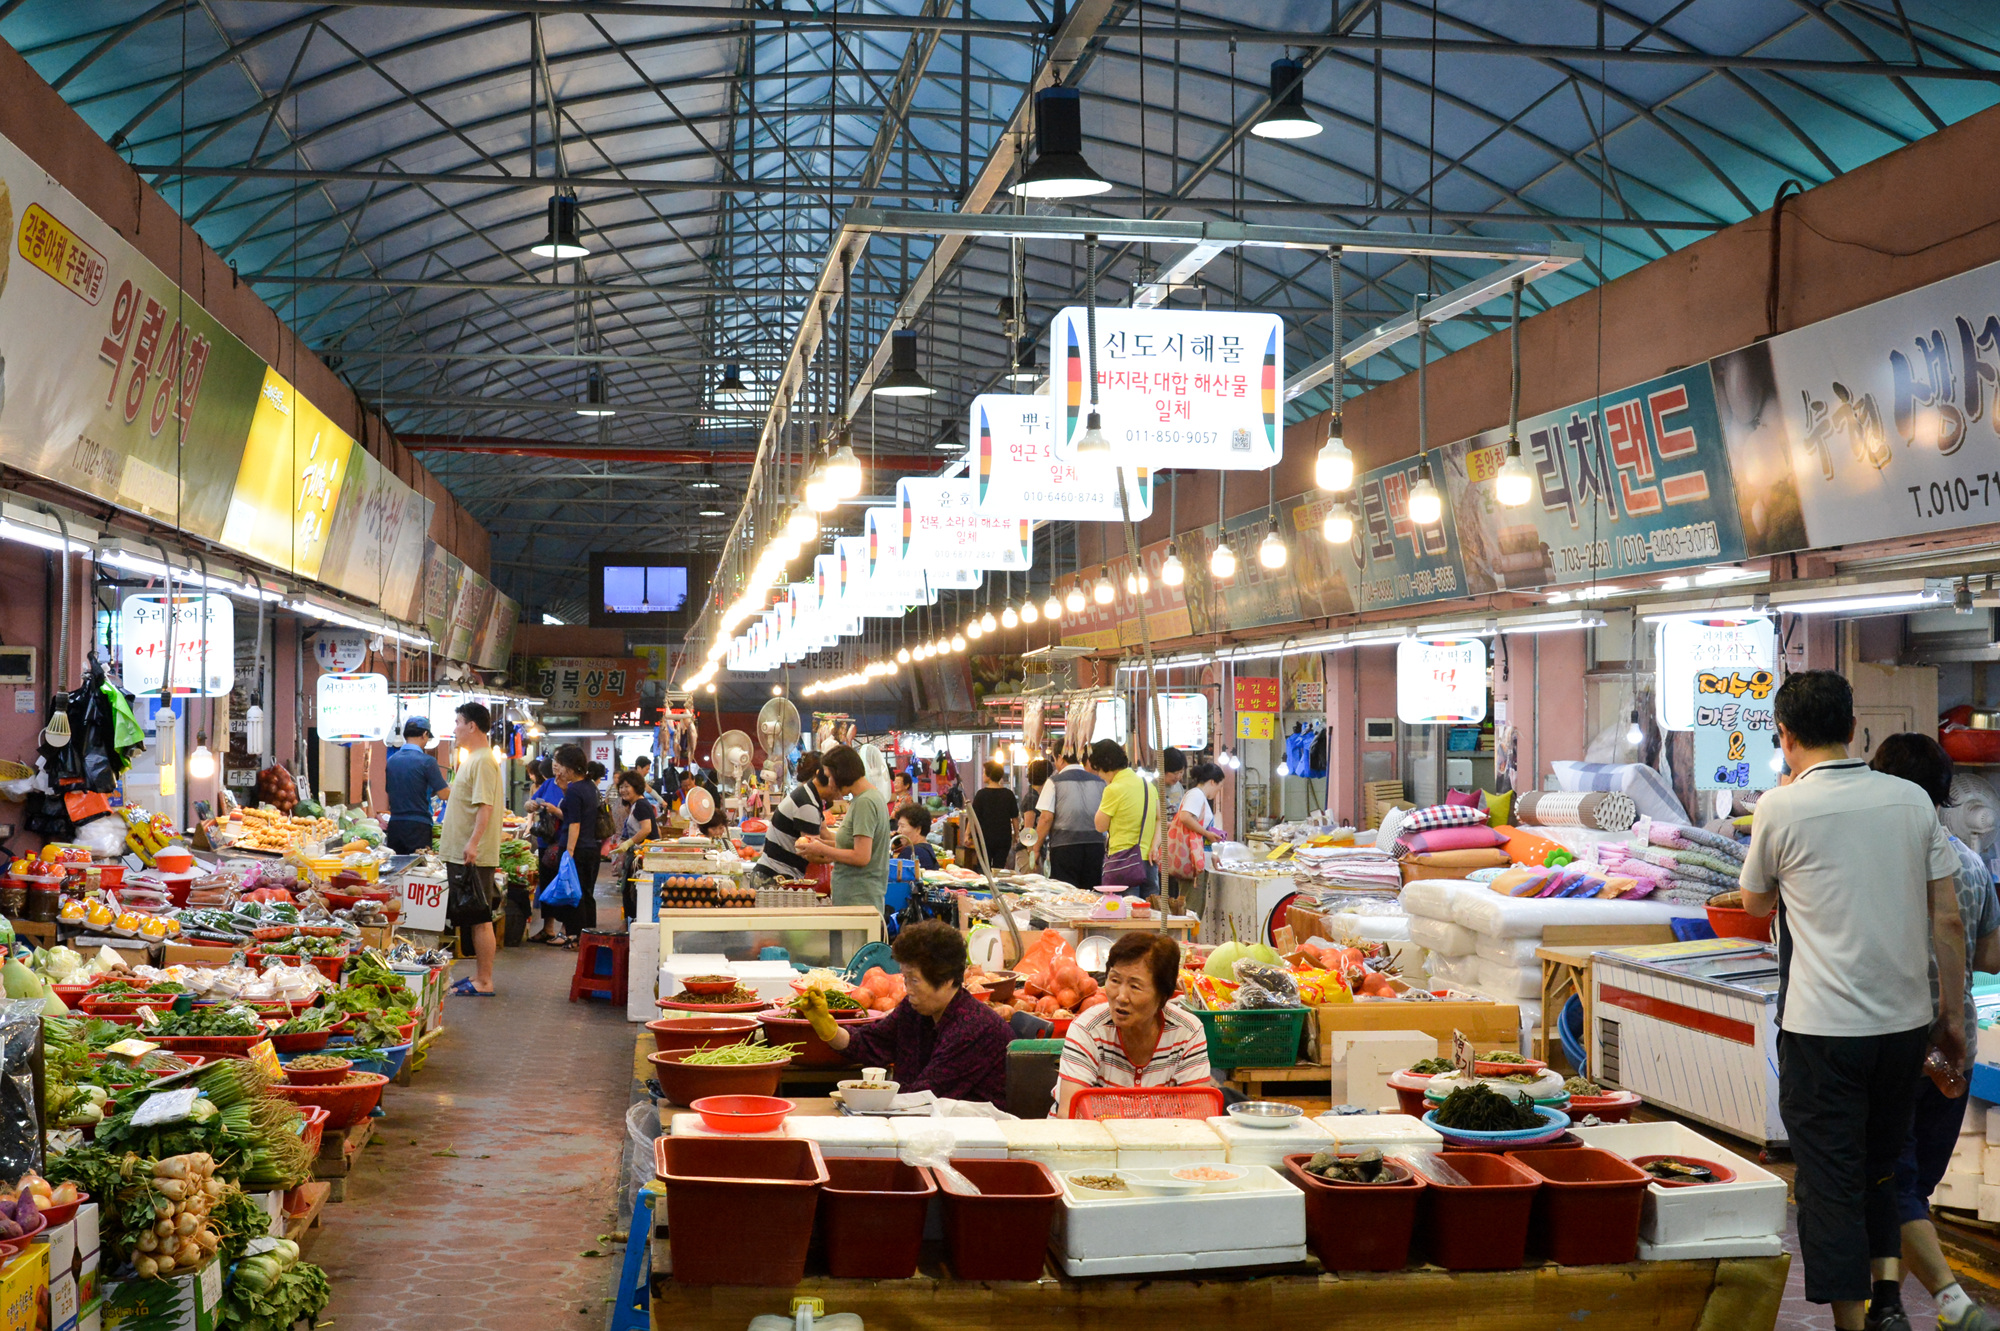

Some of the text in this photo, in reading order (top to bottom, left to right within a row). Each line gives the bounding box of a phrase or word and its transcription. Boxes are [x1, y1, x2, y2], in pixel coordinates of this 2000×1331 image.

[25, 213, 105, 299] 각종야채 주문배달
[1103, 331, 1245, 363] 신도시해물
[99, 279, 211, 446] 의령상회
[1194, 374, 1248, 397] 해산물
[1156, 400, 1191, 422] 일체
[1126, 430, 1218, 445] 011-850-9057
[1009, 444, 1037, 462] 연근
[1529, 384, 1710, 528] 리치랜드
[1024, 491, 1105, 503] 010-6460-8743
[945, 516, 966, 528] 소라
[968, 516, 978, 528] 외
[956, 531, 978, 545] 일체
[539, 669, 626, 697] 경북상회
[1433, 668, 1457, 692] 떡
[1698, 671, 1773, 699] 제수용
[1697, 703, 1741, 731] 마른
[595, 746, 610, 760] 쌀
[1728, 731, 1746, 760] &
[230, 770, 254, 784] 대추
[1714, 762, 1750, 787] 해물
[407, 882, 443, 908] 매장
